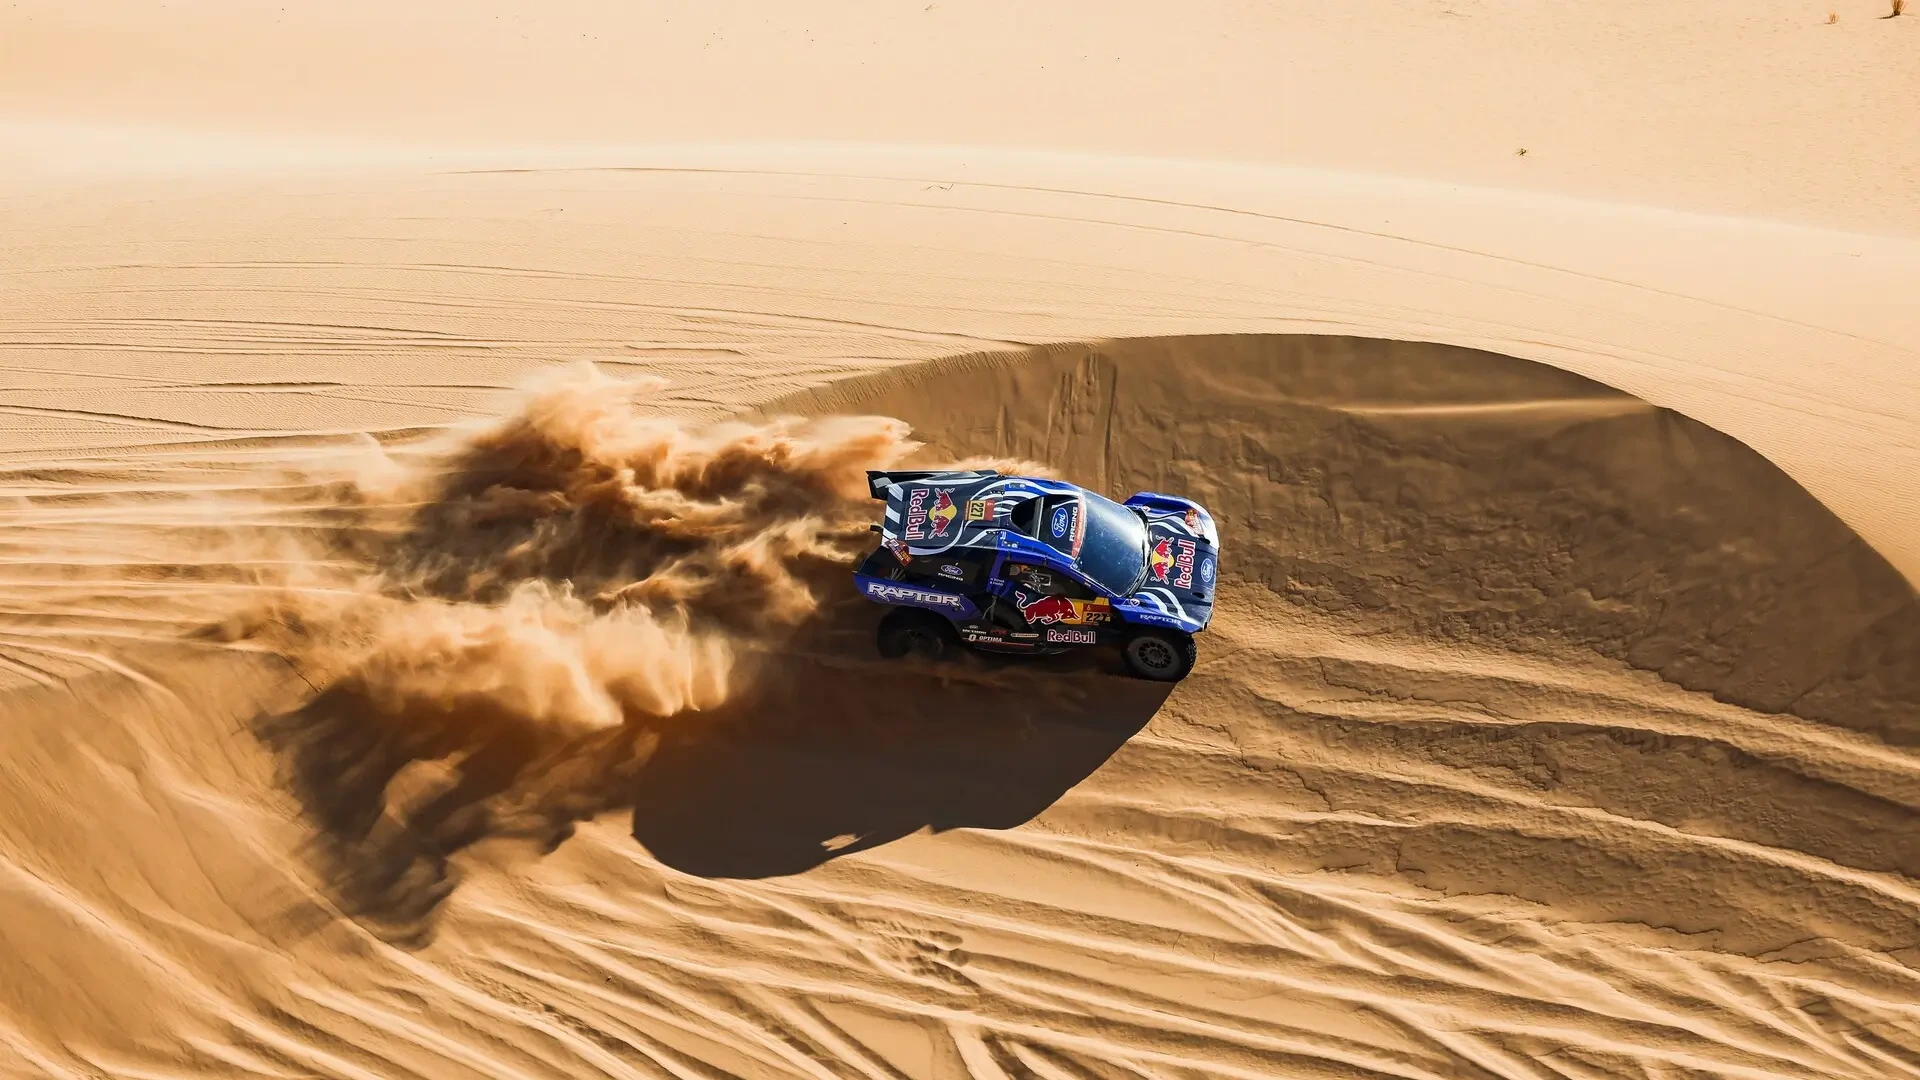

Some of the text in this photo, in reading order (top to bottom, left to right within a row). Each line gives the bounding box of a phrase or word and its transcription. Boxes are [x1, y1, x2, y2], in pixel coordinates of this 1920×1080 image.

[905, 489, 930, 540] Red Bull
[970, 502, 984, 518] 227
[1053, 511, 1067, 534] Ford
[1069, 506, 1078, 542] RACING
[1176, 539, 1196, 566] Bull
[943, 566, 961, 575] Ford
[1174, 563, 1193, 589] Red
[867, 582, 965, 611] RAPTOR
[1140, 614, 1184, 629] RAPTOR
[979, 635, 1002, 643] OPTIMA
[1047, 629, 1072, 643] Red
[1072, 630, 1096, 644] Bull
